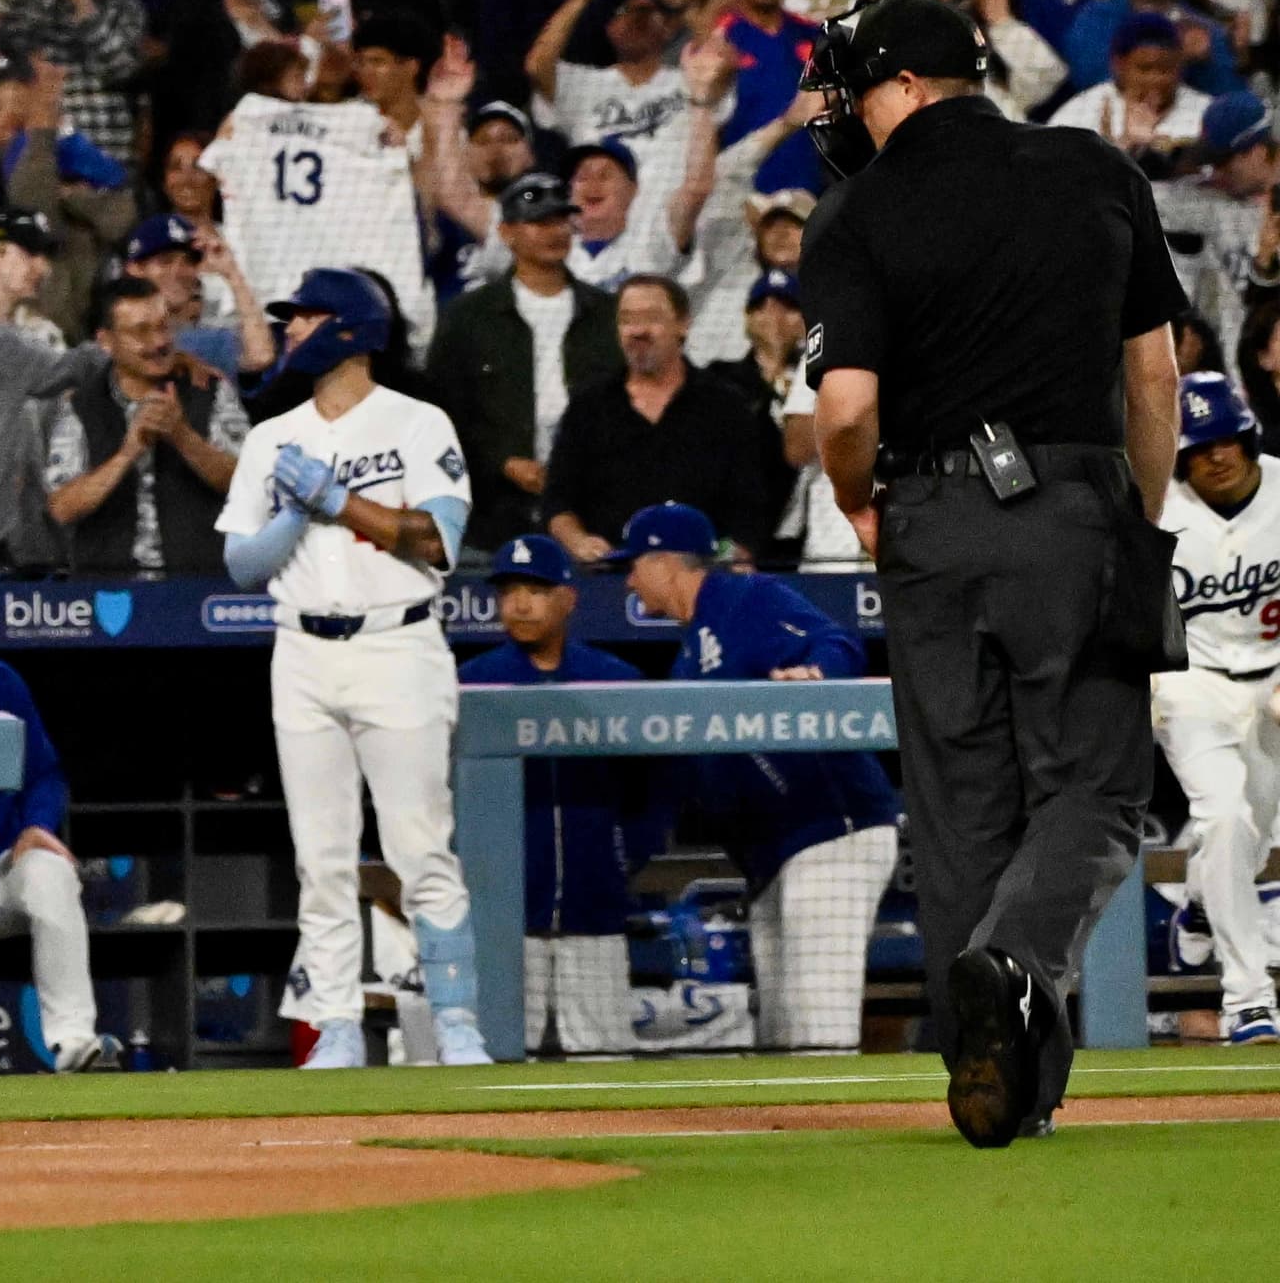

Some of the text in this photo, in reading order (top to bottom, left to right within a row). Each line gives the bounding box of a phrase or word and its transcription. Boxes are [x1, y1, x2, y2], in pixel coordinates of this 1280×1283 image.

[274, 149, 323, 205] 13
[5, 590, 93, 627] blue
[517, 710, 895, 748] BANK OF AMERICA
